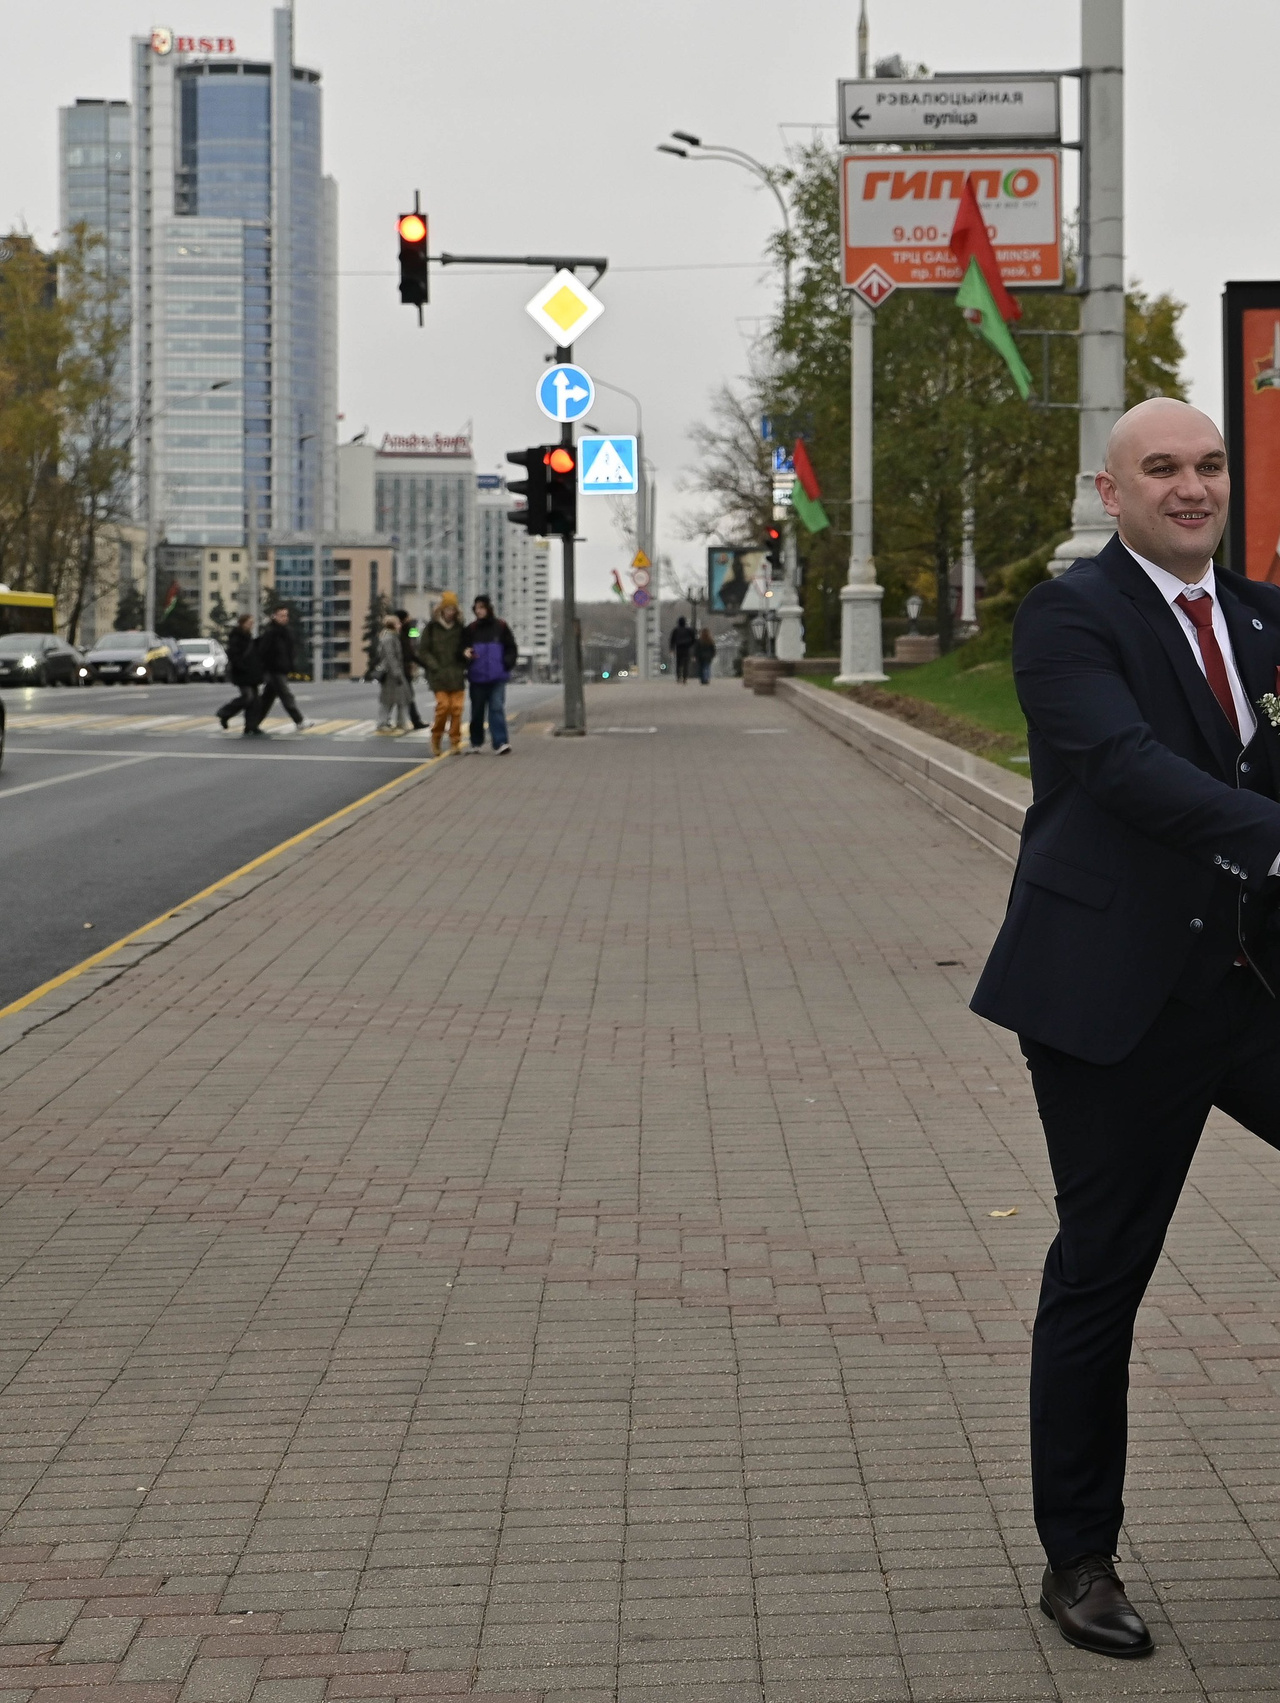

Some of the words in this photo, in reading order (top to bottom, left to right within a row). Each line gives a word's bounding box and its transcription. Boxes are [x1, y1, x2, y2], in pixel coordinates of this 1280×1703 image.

[876, 89, 1024, 107] РЭВАЛЮЦЫЙНАЯ
[923, 111, 979, 128] вуліца
[863, 169, 1039, 200] ГИППО
[891, 251, 922, 266] ТРЦ
